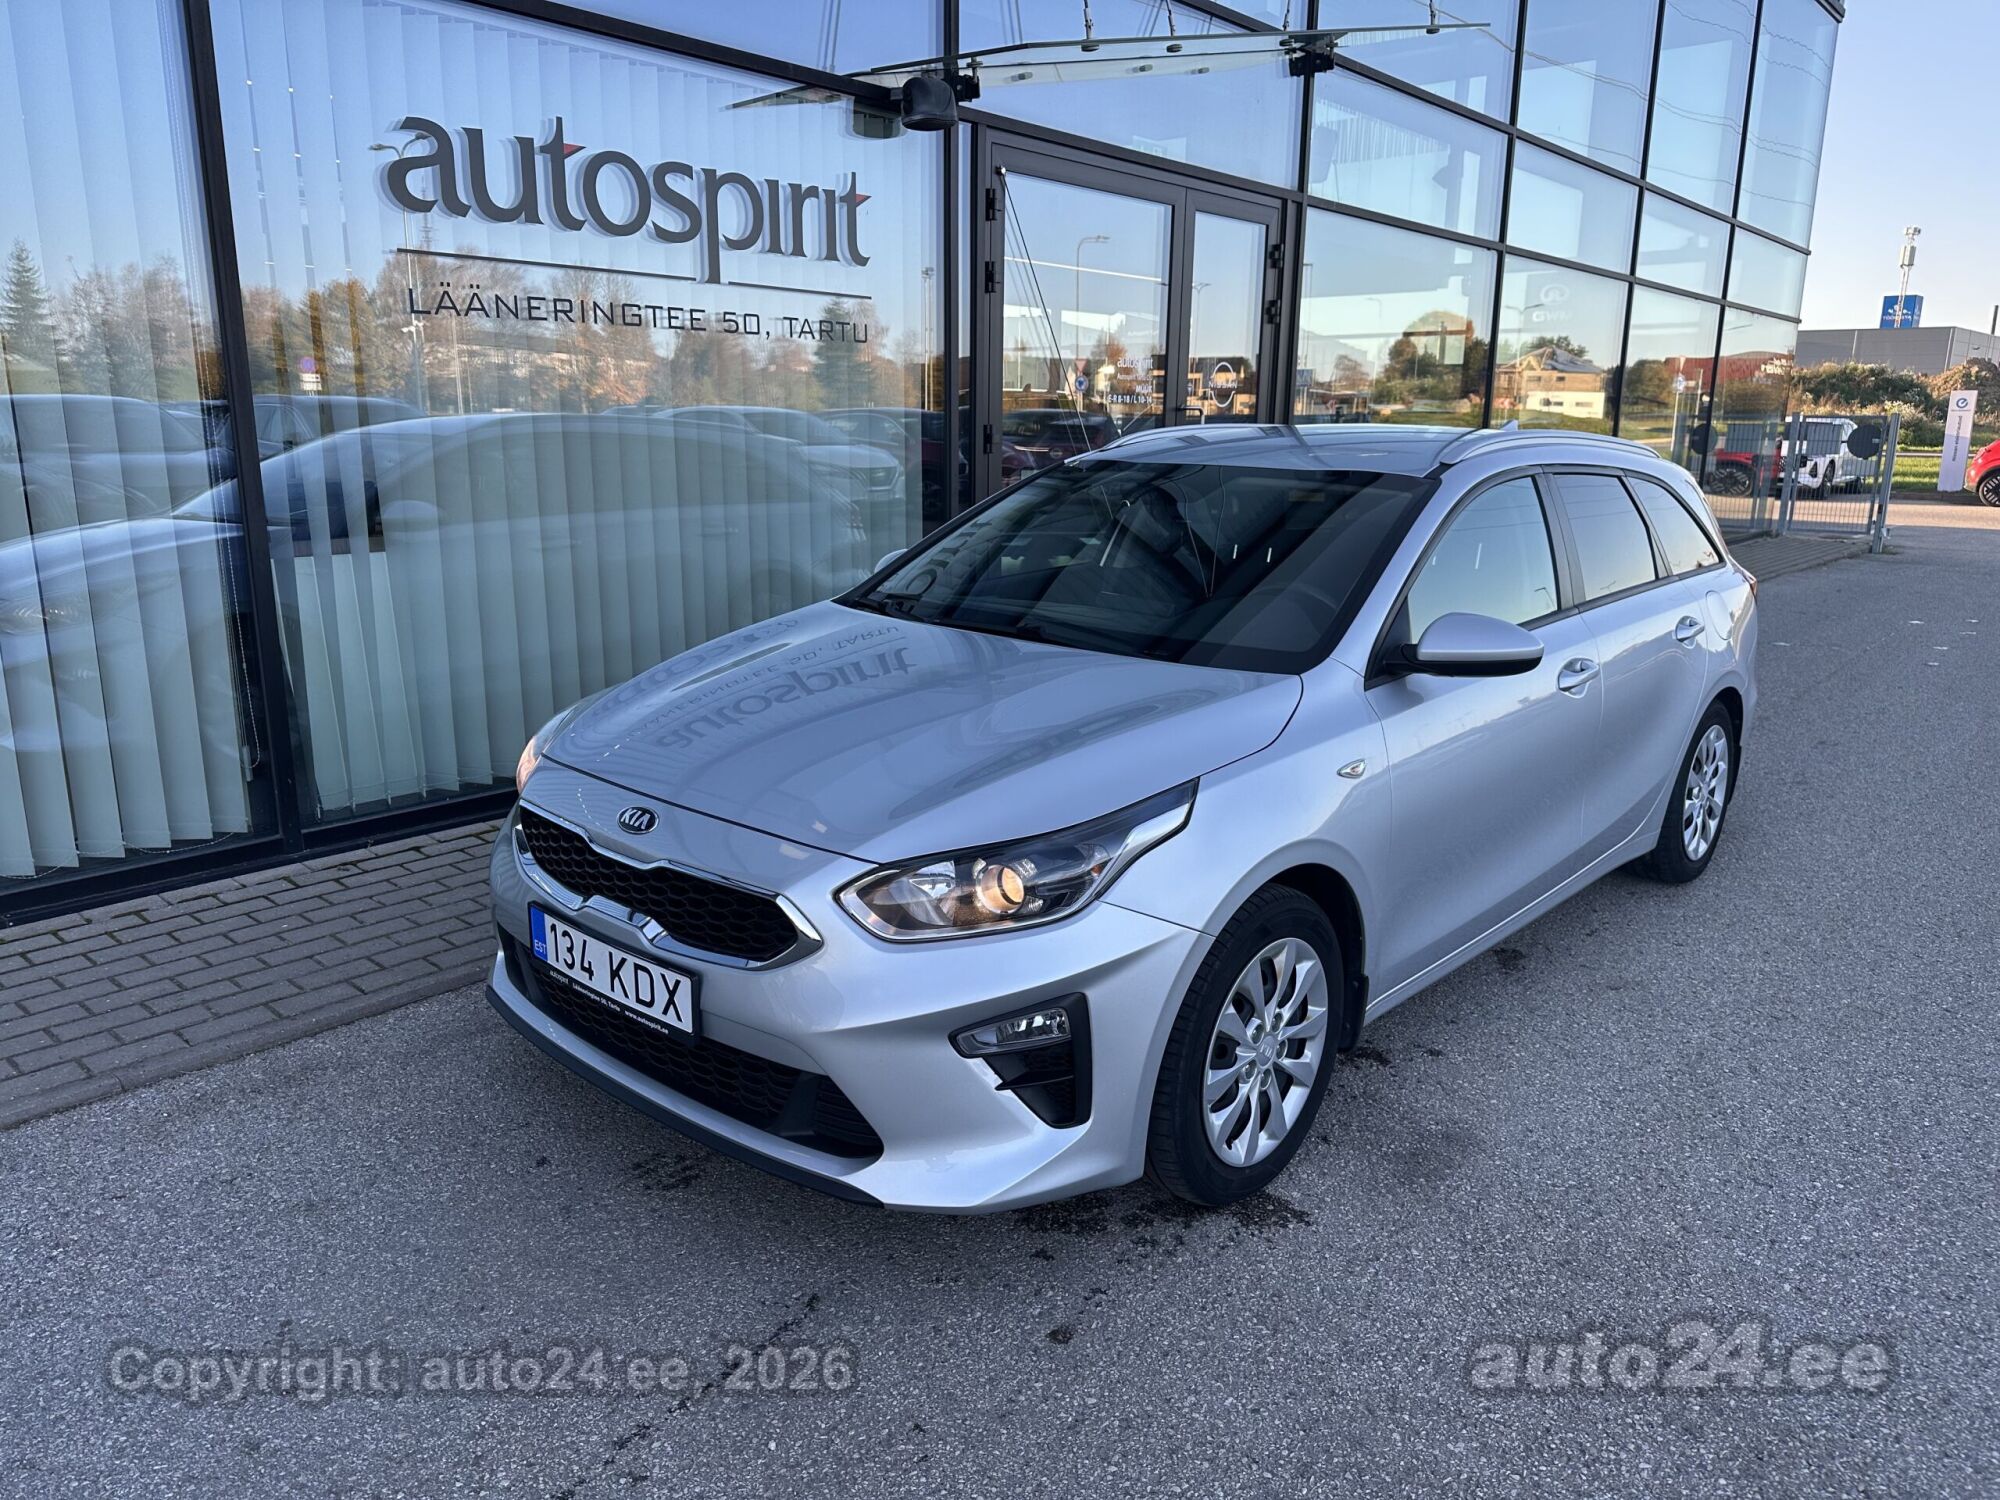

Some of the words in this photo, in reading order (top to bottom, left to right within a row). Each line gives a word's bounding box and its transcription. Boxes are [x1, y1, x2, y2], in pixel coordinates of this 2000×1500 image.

[386, 115, 872, 285] autospirit
[407, 281, 708, 332] LÄÄNERINGTEE
[722, 311, 771, 339] 50,
[782, 315, 869, 344] TARTU
[1208, 380, 1238, 389] NISSAN
[620, 808, 651, 830] KIA
[534, 939, 547, 954] EST
[550, 922, 594, 981] 134
[608, 950, 684, 1023] KDX
